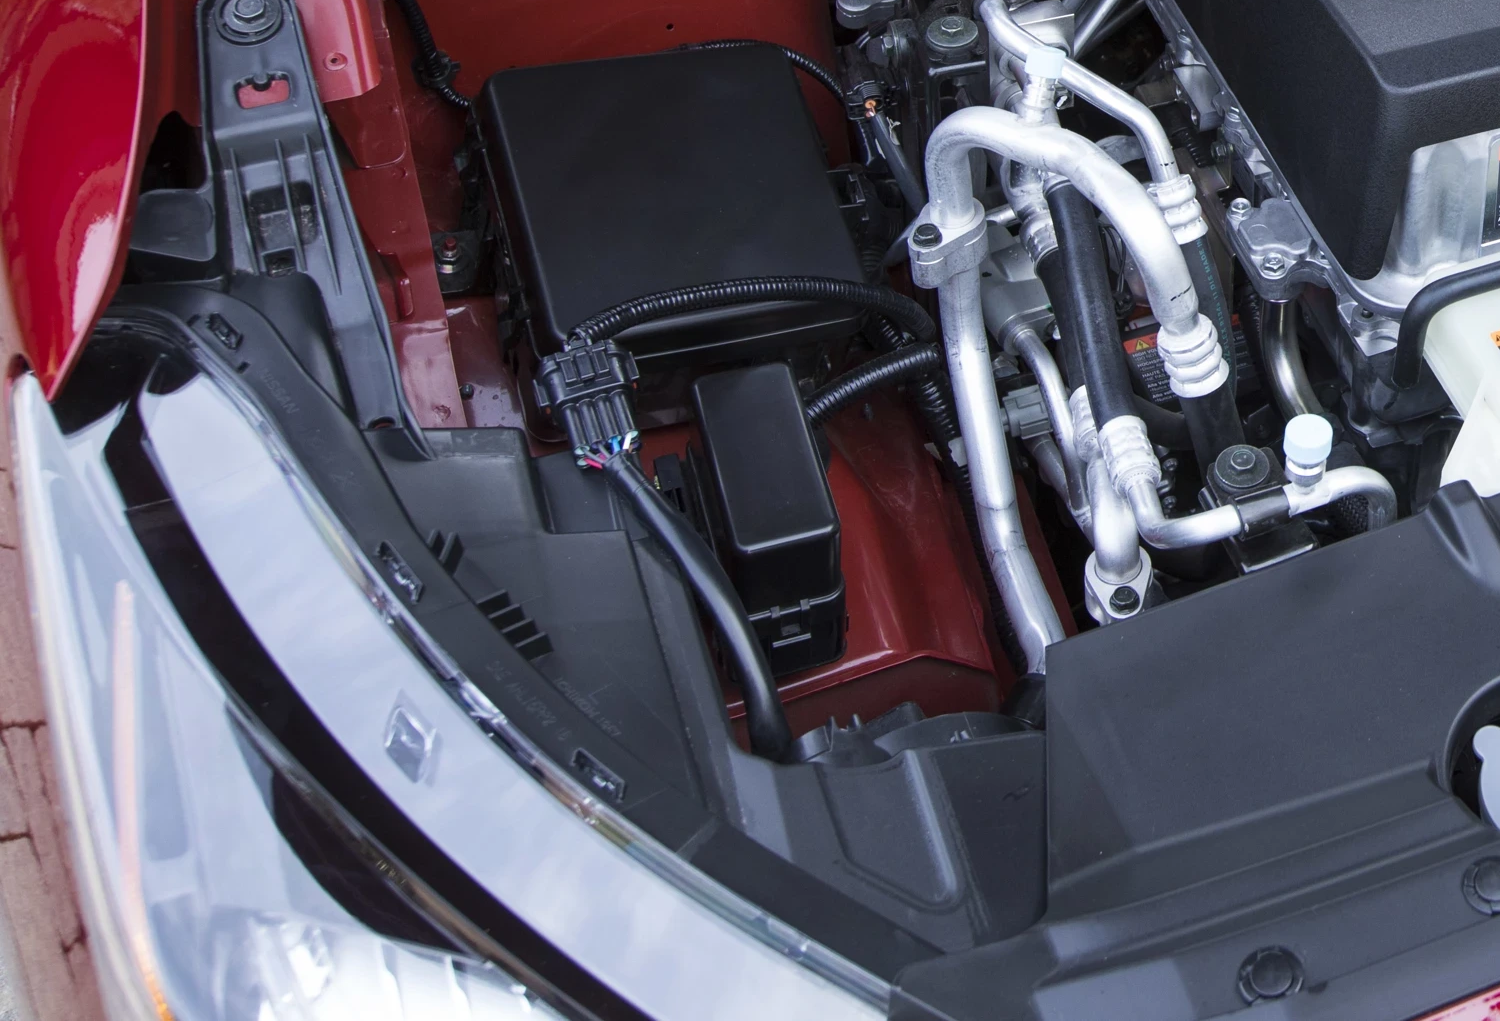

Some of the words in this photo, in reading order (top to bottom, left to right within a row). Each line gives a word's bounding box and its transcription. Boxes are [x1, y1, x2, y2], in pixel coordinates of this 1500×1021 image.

[1199, 250, 1211, 274] MADE
[1142, 369, 1160, 378] HAUTE
[257, 366, 301, 415] NISSAN
